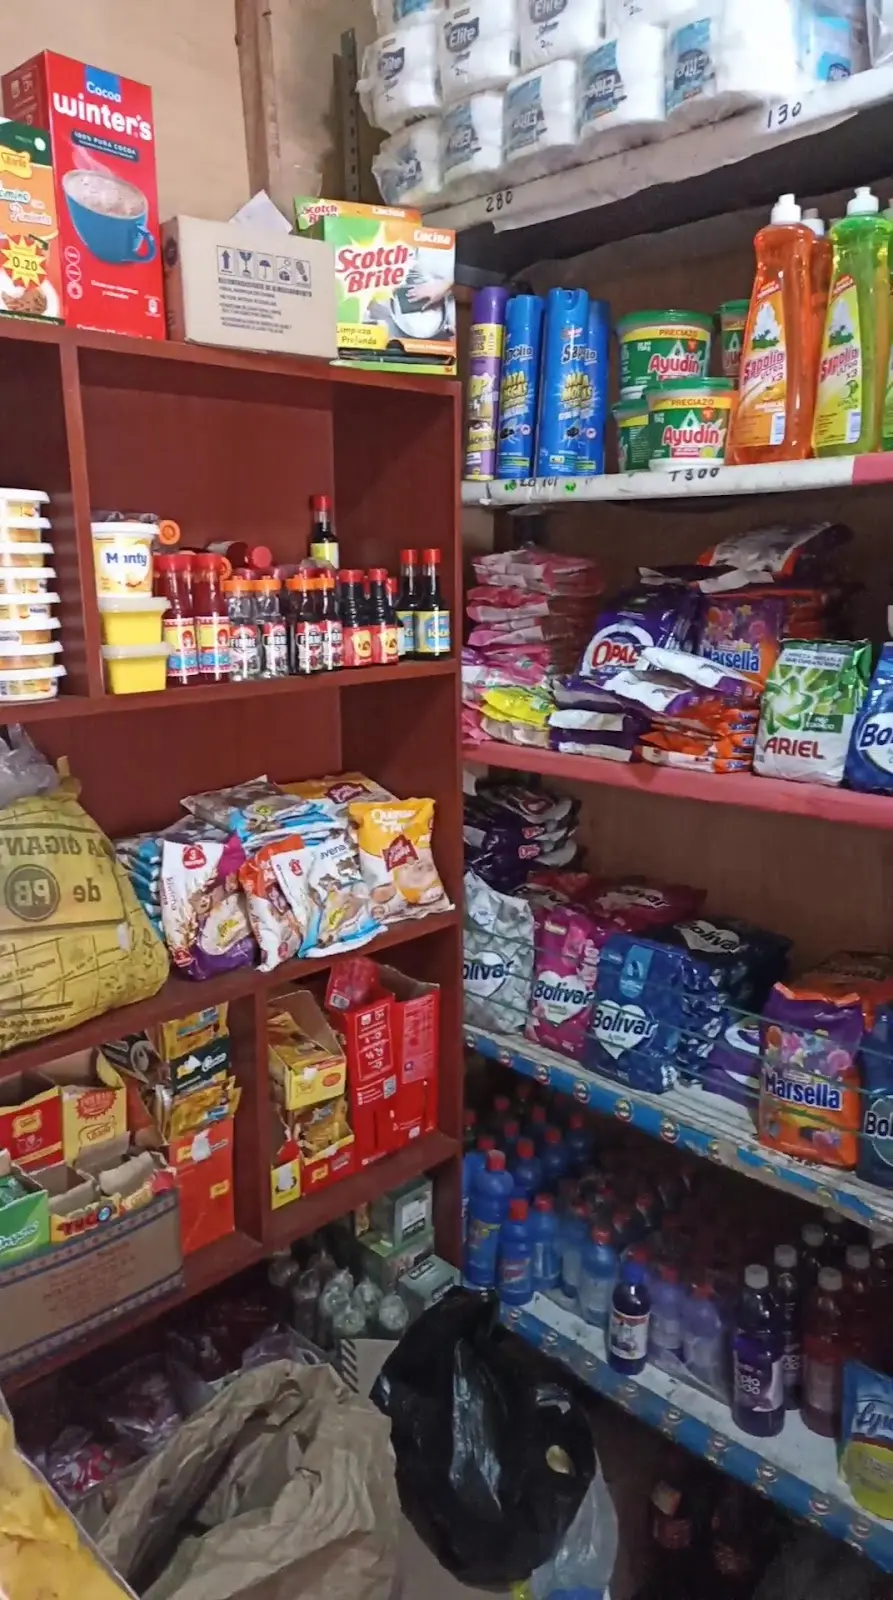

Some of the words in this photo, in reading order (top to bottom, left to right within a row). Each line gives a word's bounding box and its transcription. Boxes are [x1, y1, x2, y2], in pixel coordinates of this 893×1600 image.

[450, 25, 476, 47] Elite
[86, 80, 122, 103] Cocoa
[52, 91, 153, 141] winter's
[766, 101, 802, 129] 130
[93, 136, 112, 148] PURA
[113, 143, 136, 155] COCOA
[485, 190, 514, 213] 280
[12, 256, 38, 272] 0.20
[344, 267, 405, 294] Brite
[659, 328, 699, 337] PRECIAZO
[649, 354, 700, 375] Ayudín
[744, 351, 785, 384] Sapolio
[671, 398, 715, 407] PRECIAZO
[663, 425, 719, 446] Ayudín
[764, 736, 825, 760] ARIEL
[533, 980, 595, 1005] Bolivar
[593, 1009, 655, 1036] Bolivar
[764, 1071, 843, 1111] Marsella
